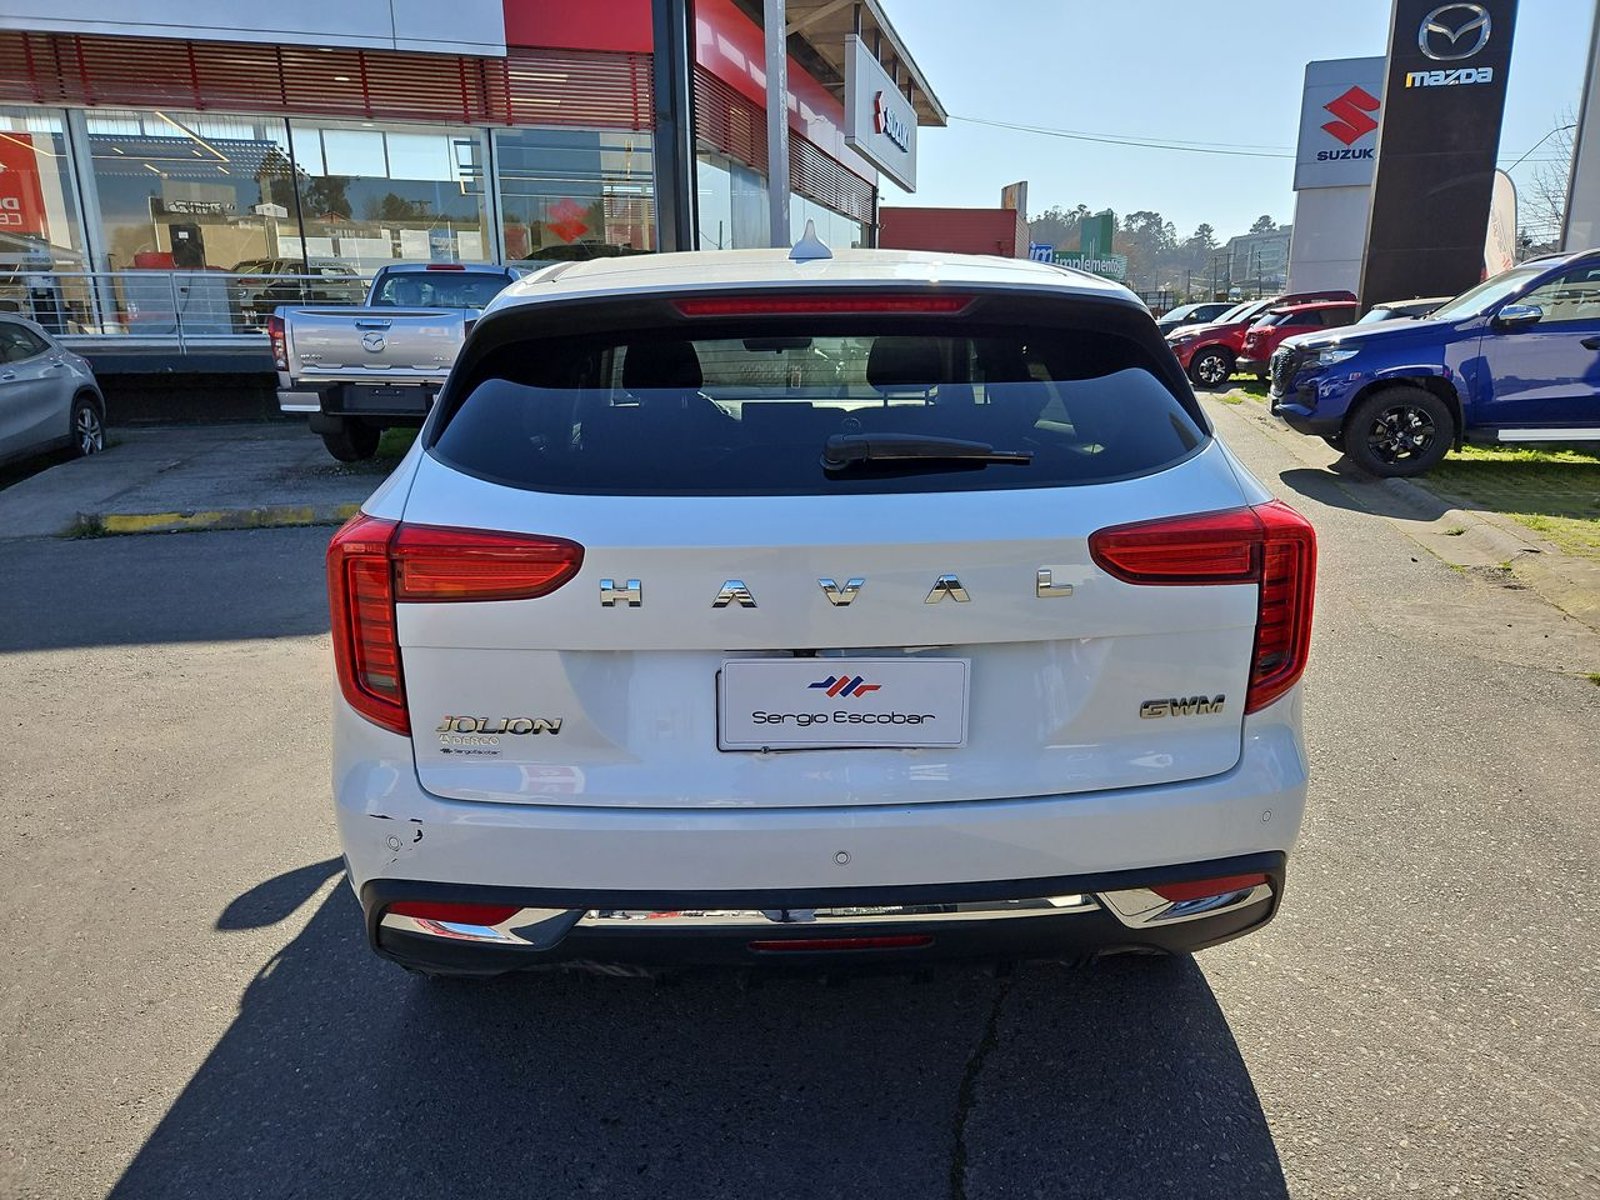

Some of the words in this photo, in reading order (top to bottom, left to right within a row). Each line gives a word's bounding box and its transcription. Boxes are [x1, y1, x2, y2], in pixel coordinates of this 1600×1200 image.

[1405, 67, 1493, 88] mazda
[1317, 148, 1376, 161] SUZUK
[599, 569, 1074, 608] HAVAL
[1139, 694, 1226, 719] GWM
[436, 715, 563, 735] JOLION
[752, 711, 829, 727] Sergio
[833, 710, 936, 725] Escobar
